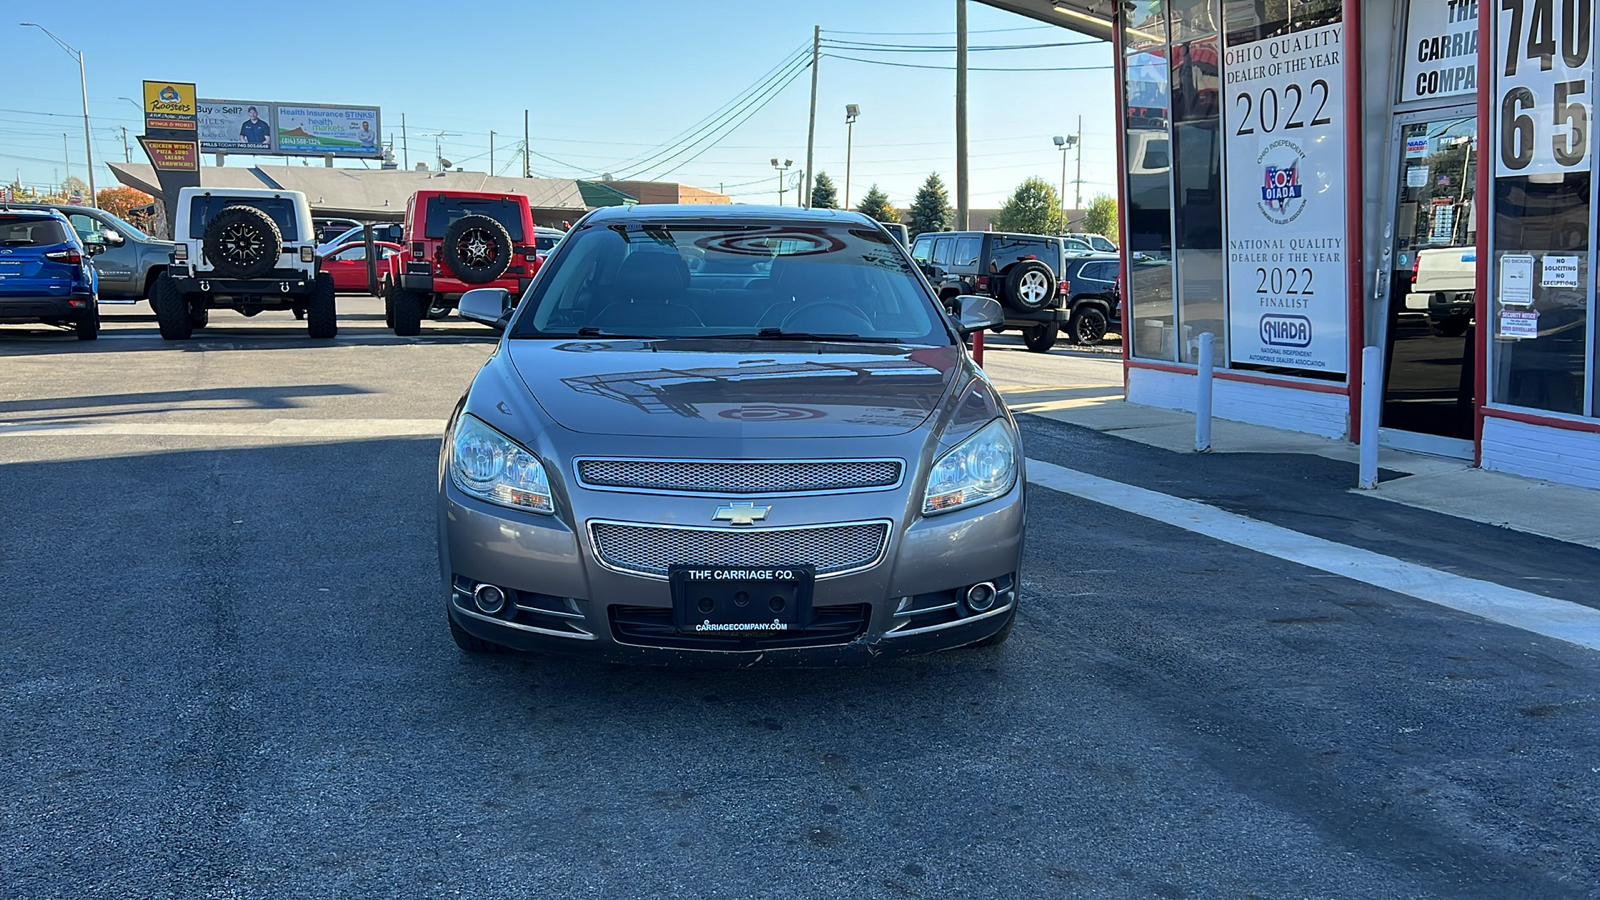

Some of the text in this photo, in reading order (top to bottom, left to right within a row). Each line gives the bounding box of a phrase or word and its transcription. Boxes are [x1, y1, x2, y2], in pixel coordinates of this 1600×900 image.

[1448, 0, 1478, 24] THE
[1501, 0, 1591, 77] 740
[1226, 45, 1262, 65] OHIO
[1269, 28, 1341, 58] QUALITY
[1227, 51, 1340, 84] DEALER OF THE YEAR
[1416, 65, 1477, 96] COMPA
[150, 99, 191, 112] Roosters
[222, 106, 243, 115] Sell?
[1236, 79, 1331, 136] 2022
[280, 108, 375, 119] Health Insurance STINKS!
[308, 117, 333, 126] health
[312, 124, 345, 132] markets
[1257, 140, 1306, 164] OHIO INDEPENDENT
[1266, 187, 1295, 199] OIADA
[1230, 239, 1341, 250] NATIONAL QUALITY
[1231, 253, 1340, 262] DEALER OF THE YEAR
[1256, 267, 1314, 295] 2022
[1260, 298, 1308, 308] FINALIST
[1264, 321, 1307, 342] NIADA
[1282, 349, 1312, 357] INDEPENDENT
[1249, 355, 1325, 367] AUTOMOBILE DEALERS ASSOCIATION
[689, 570, 795, 580] THE CARRIAGE CO.
[695, 623, 788, 631] CARRIAGECOMPANY.COM
